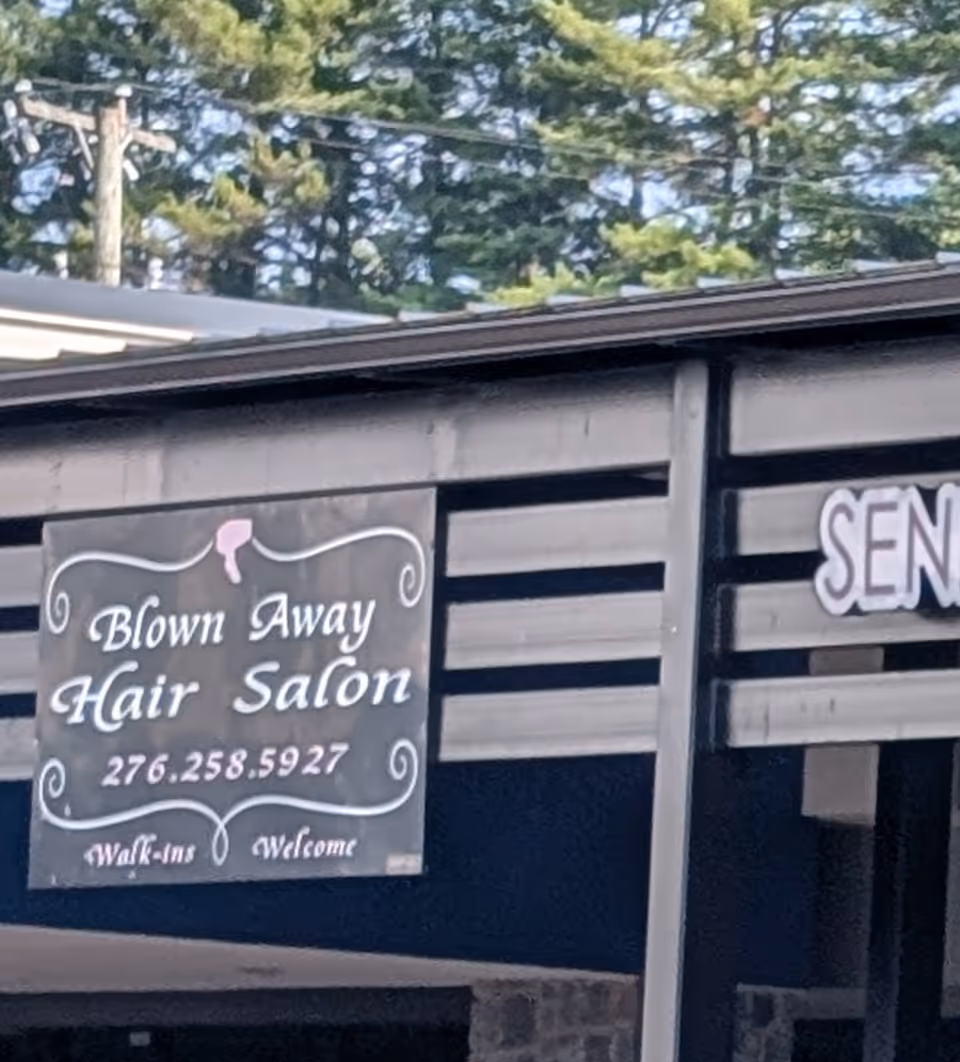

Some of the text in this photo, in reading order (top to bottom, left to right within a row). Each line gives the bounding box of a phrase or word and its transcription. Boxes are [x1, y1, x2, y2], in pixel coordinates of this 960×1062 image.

[89, 592, 376, 655] Blown Away
[49, 656, 412, 732] Hair Salon
[101, 742, 350, 787] 276.258.5927
[83, 827, 357, 868] Walk-ins Welcome
